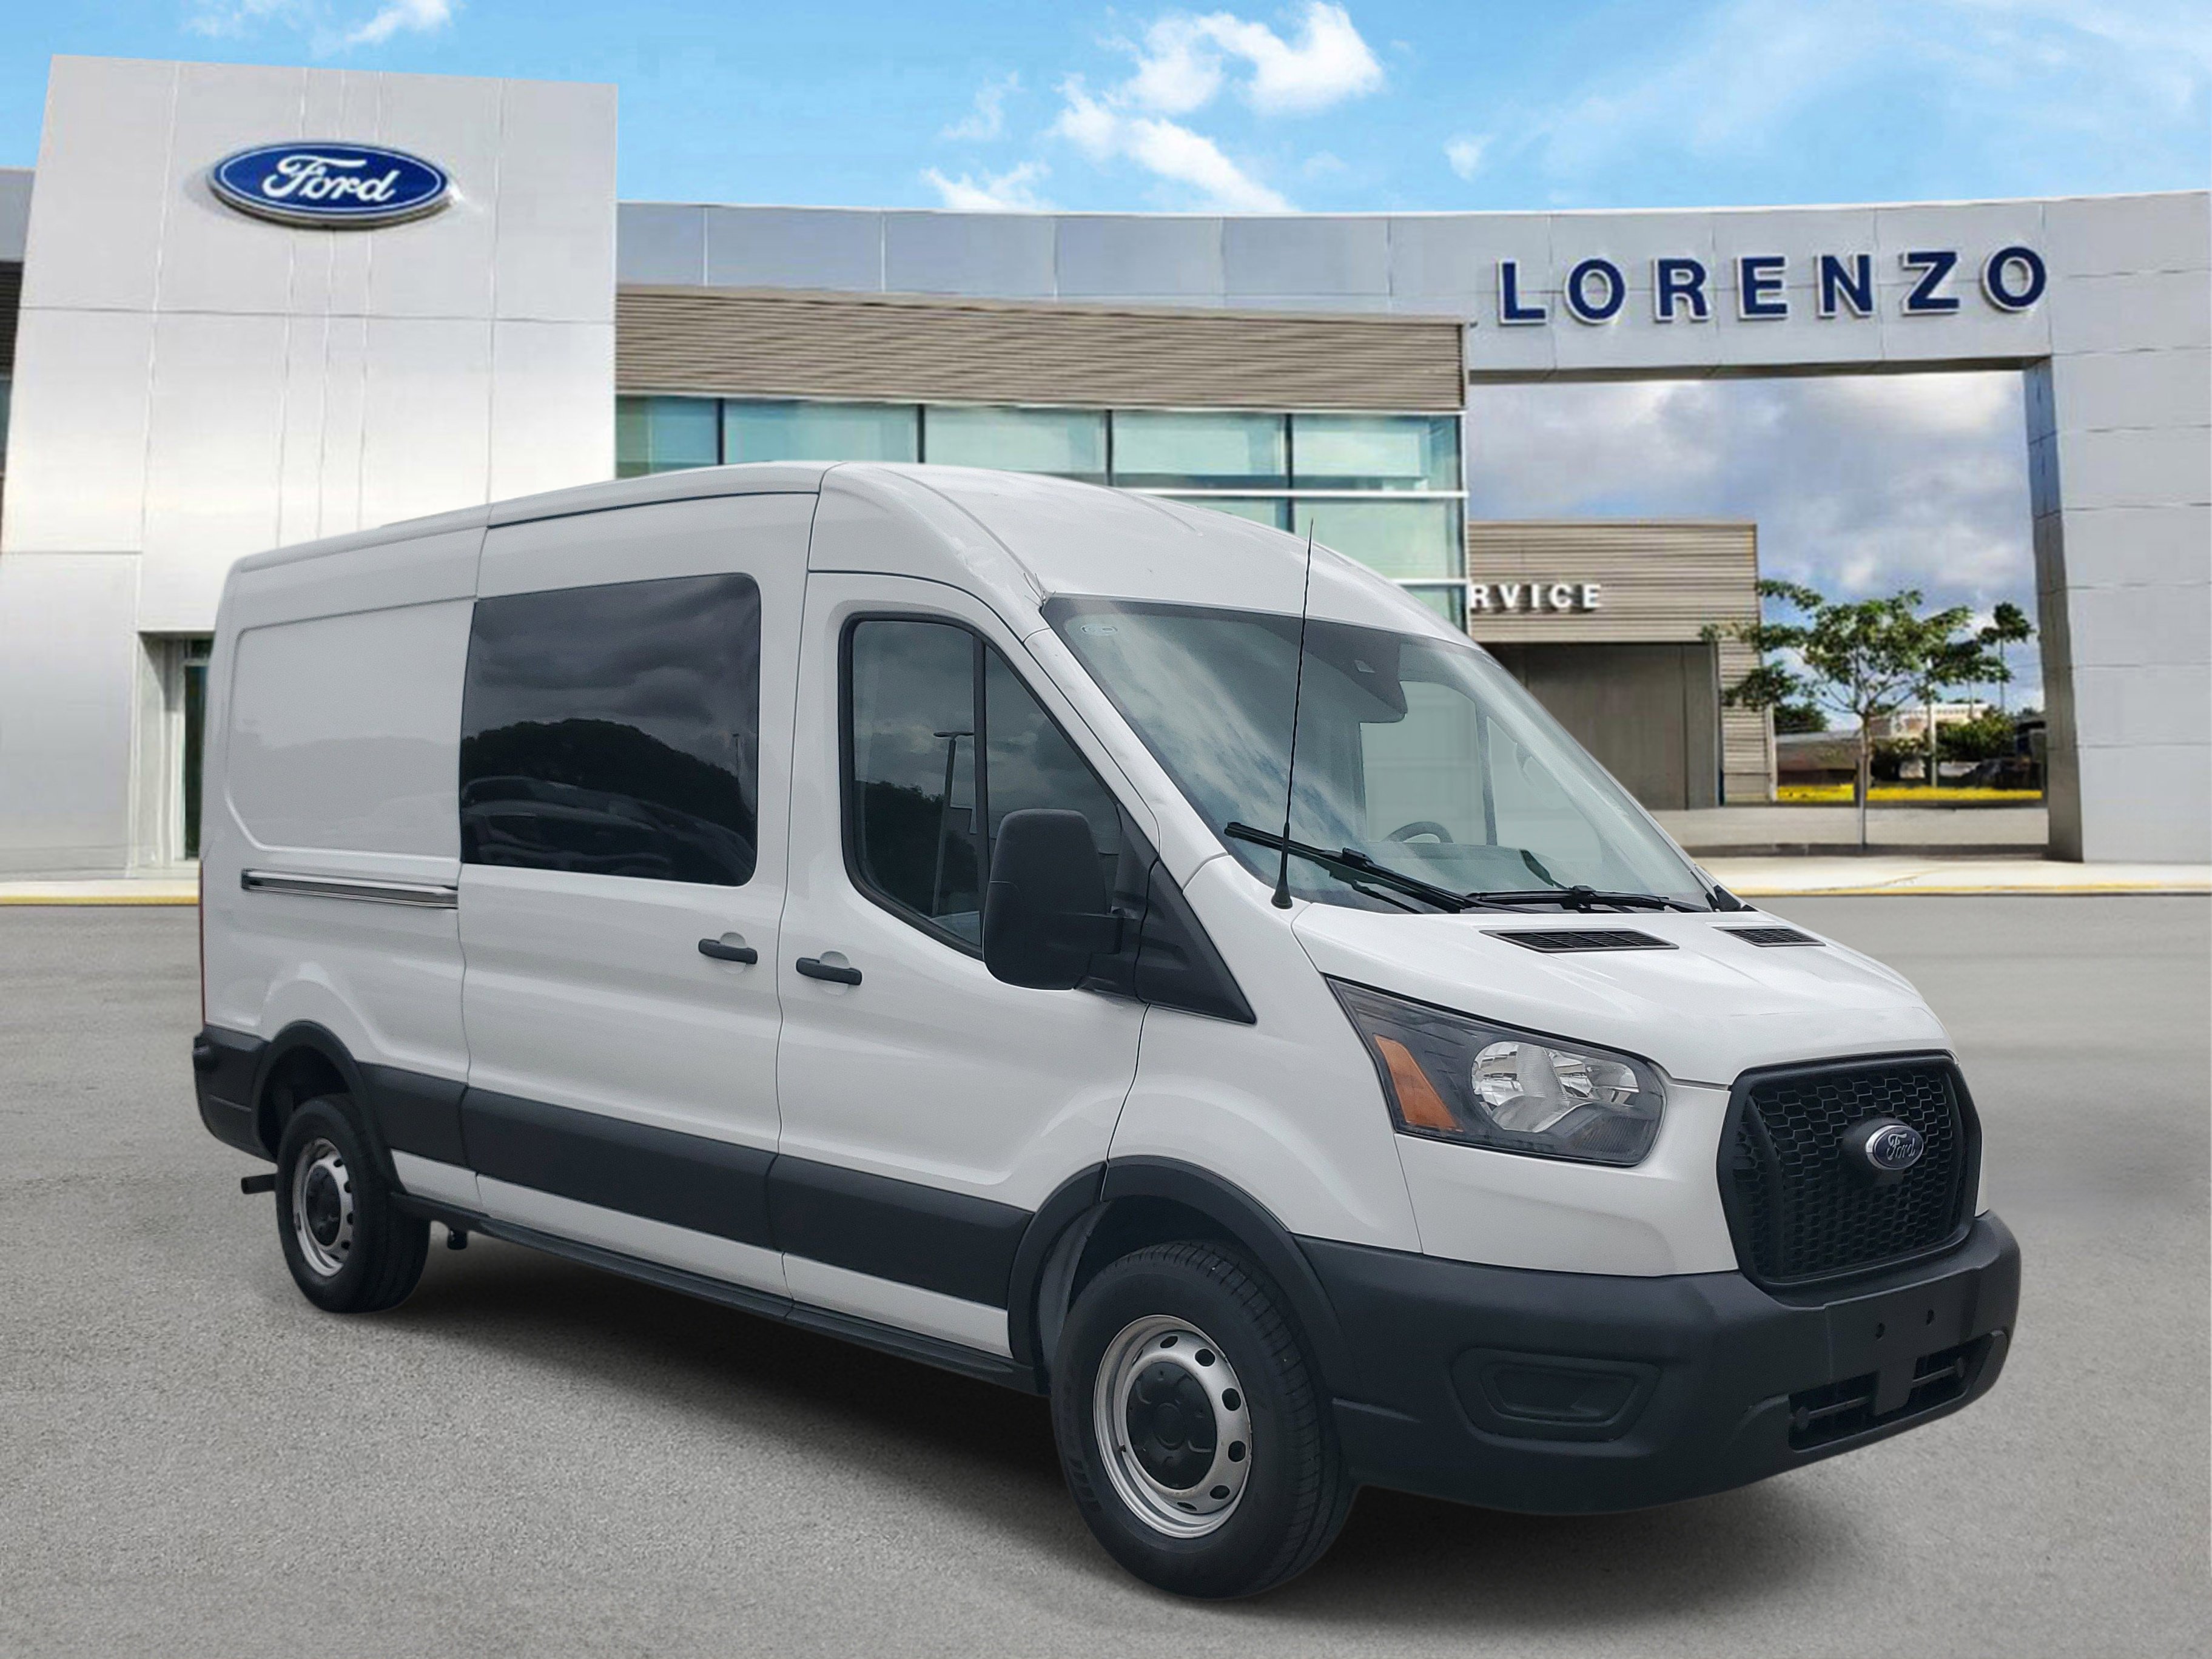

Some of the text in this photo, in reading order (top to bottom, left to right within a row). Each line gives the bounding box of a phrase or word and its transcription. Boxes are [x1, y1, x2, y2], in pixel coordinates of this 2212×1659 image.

[263, 155, 400, 201] Ford
[1499, 246, 2047, 323] LORENZO
[1886, 1133, 1915, 1160] Ford
